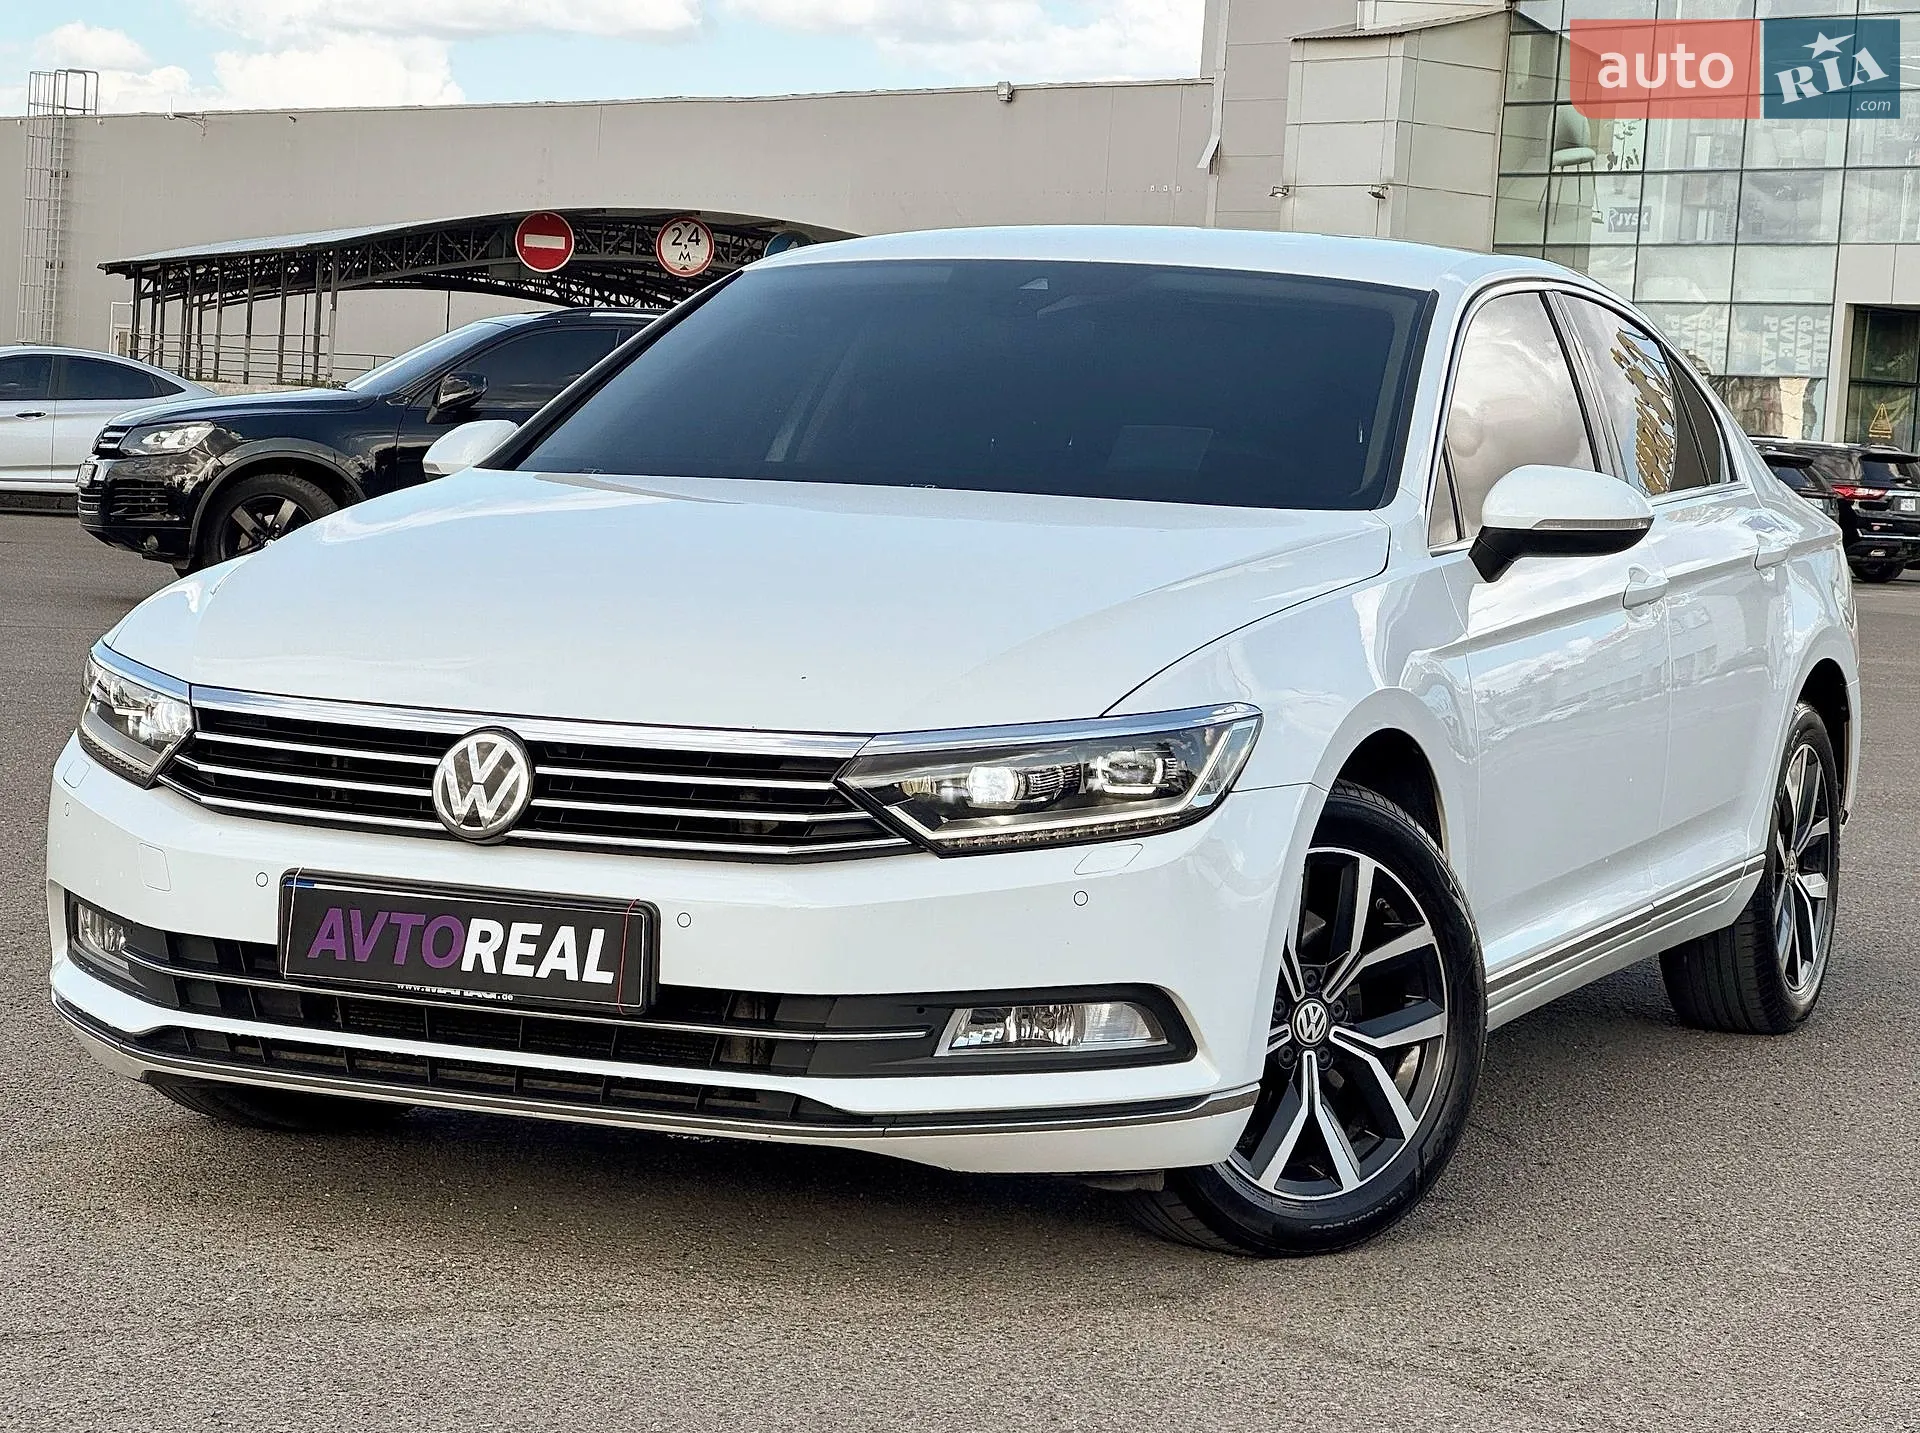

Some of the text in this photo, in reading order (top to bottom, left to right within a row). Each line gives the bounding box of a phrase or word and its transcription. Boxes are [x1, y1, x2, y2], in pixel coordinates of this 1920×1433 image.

[1616, 211, 1649, 227] JYSK
[671, 226, 702, 250] 2,4
[307, 907, 616, 985] AVTOREAL
